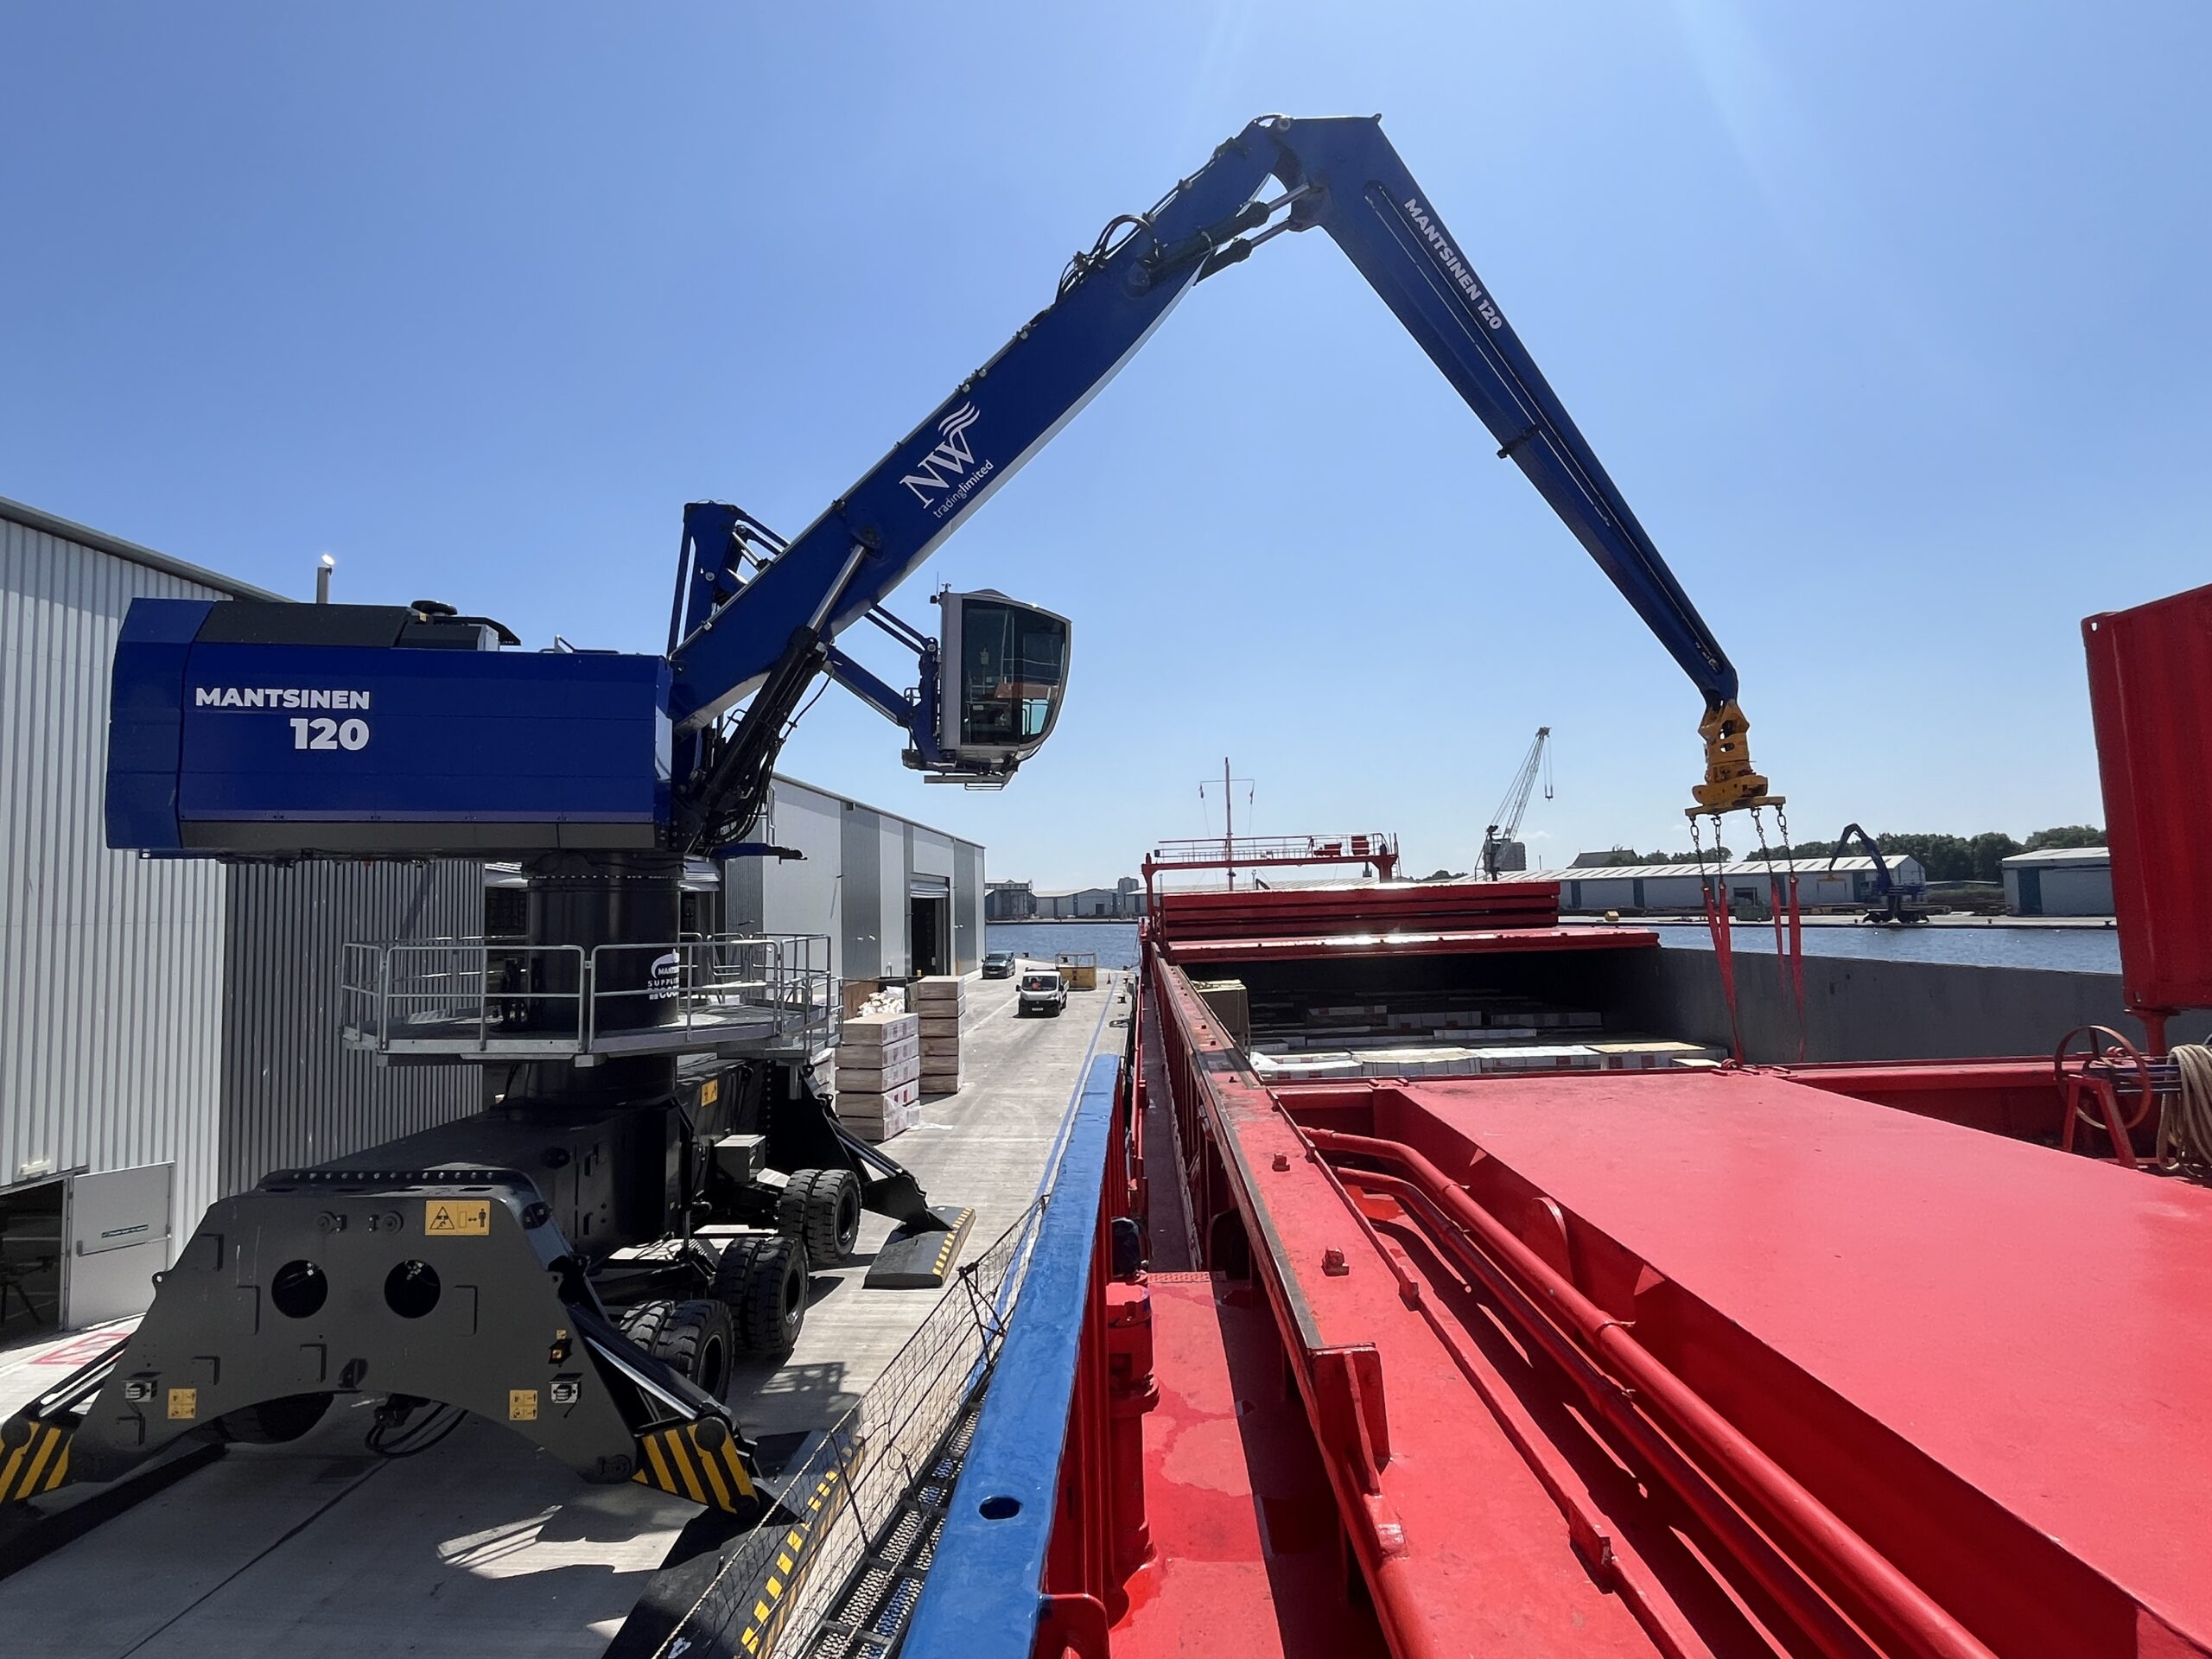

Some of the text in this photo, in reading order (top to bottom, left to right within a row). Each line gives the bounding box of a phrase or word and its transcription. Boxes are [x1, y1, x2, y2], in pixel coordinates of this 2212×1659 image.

[1404, 199, 1503, 330] MANTSINEN 120
[899, 410, 980, 509] NW
[195, 688, 370, 709] MANTSINEN
[289, 717, 370, 751] 120
